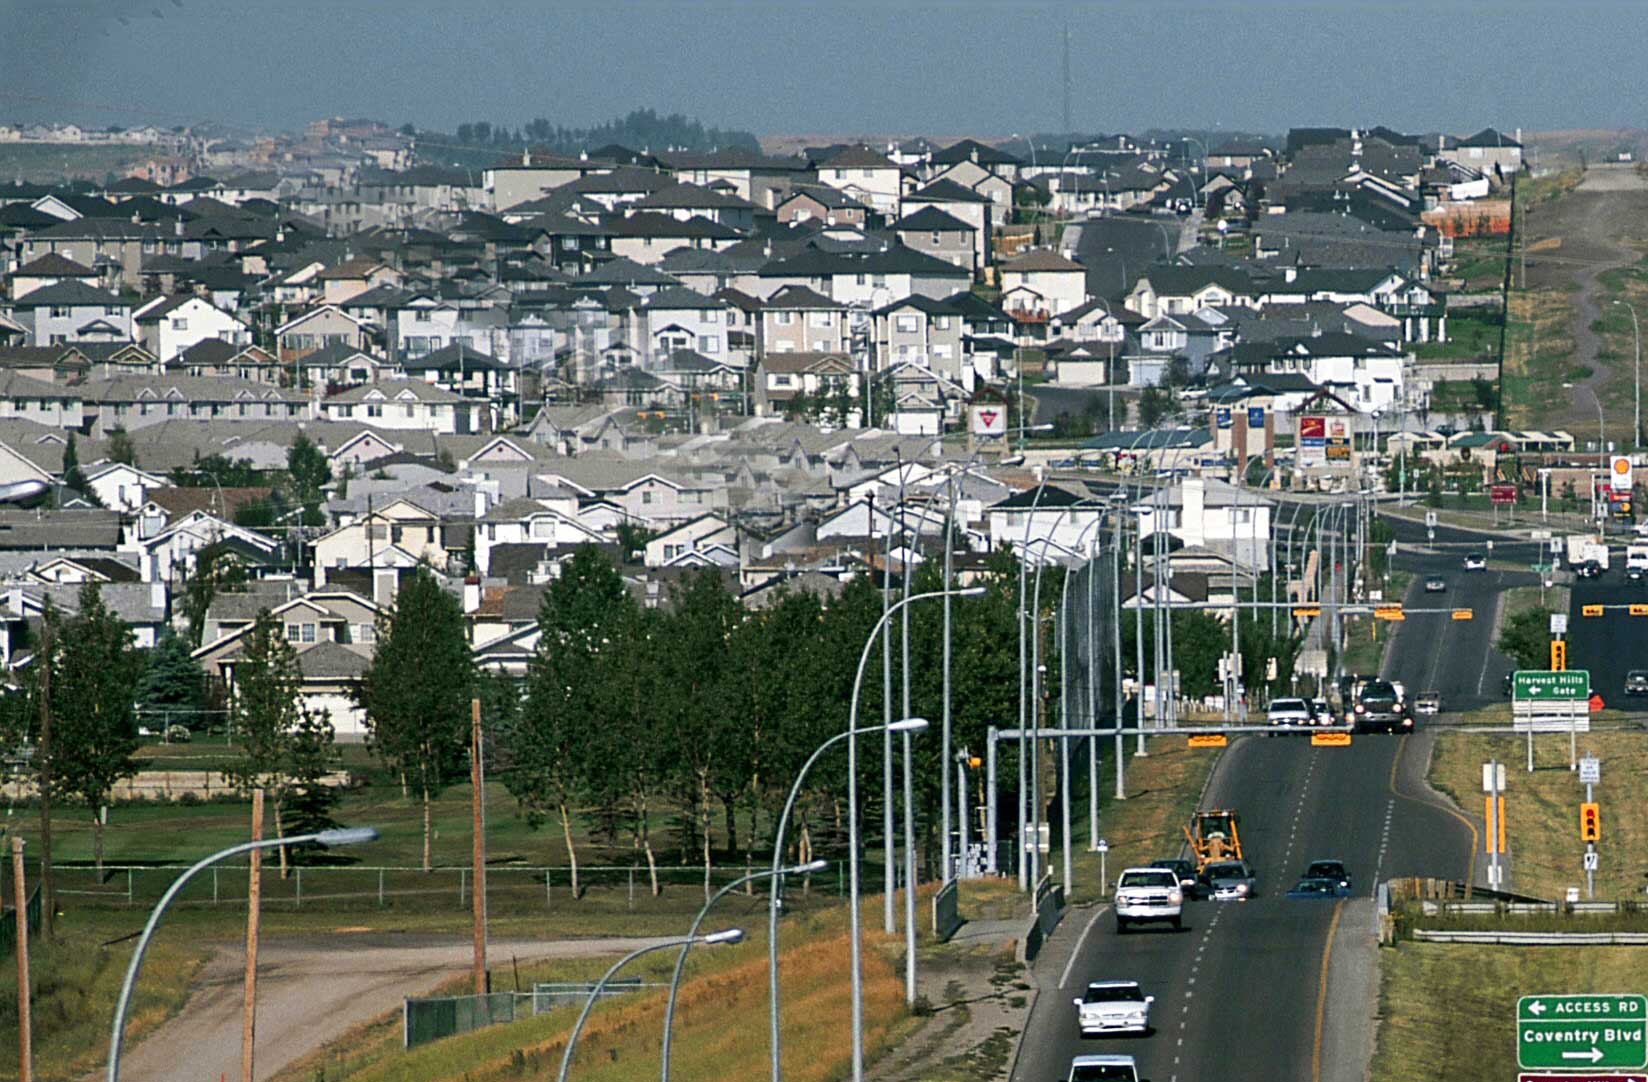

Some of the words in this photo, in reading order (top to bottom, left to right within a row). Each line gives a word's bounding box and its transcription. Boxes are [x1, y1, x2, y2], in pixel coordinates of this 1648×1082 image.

[1518, 677, 1556, 685] Harvest
[1559, 676, 1584, 684] Hills
[1552, 686, 1576, 695] Gate
[1555, 1002, 1611, 1013] ACCESS
[1618, 1001, 1639, 1013] RD
[1524, 1030, 1599, 1044] Coventry
[1604, 1029, 1642, 1042] Blvd
